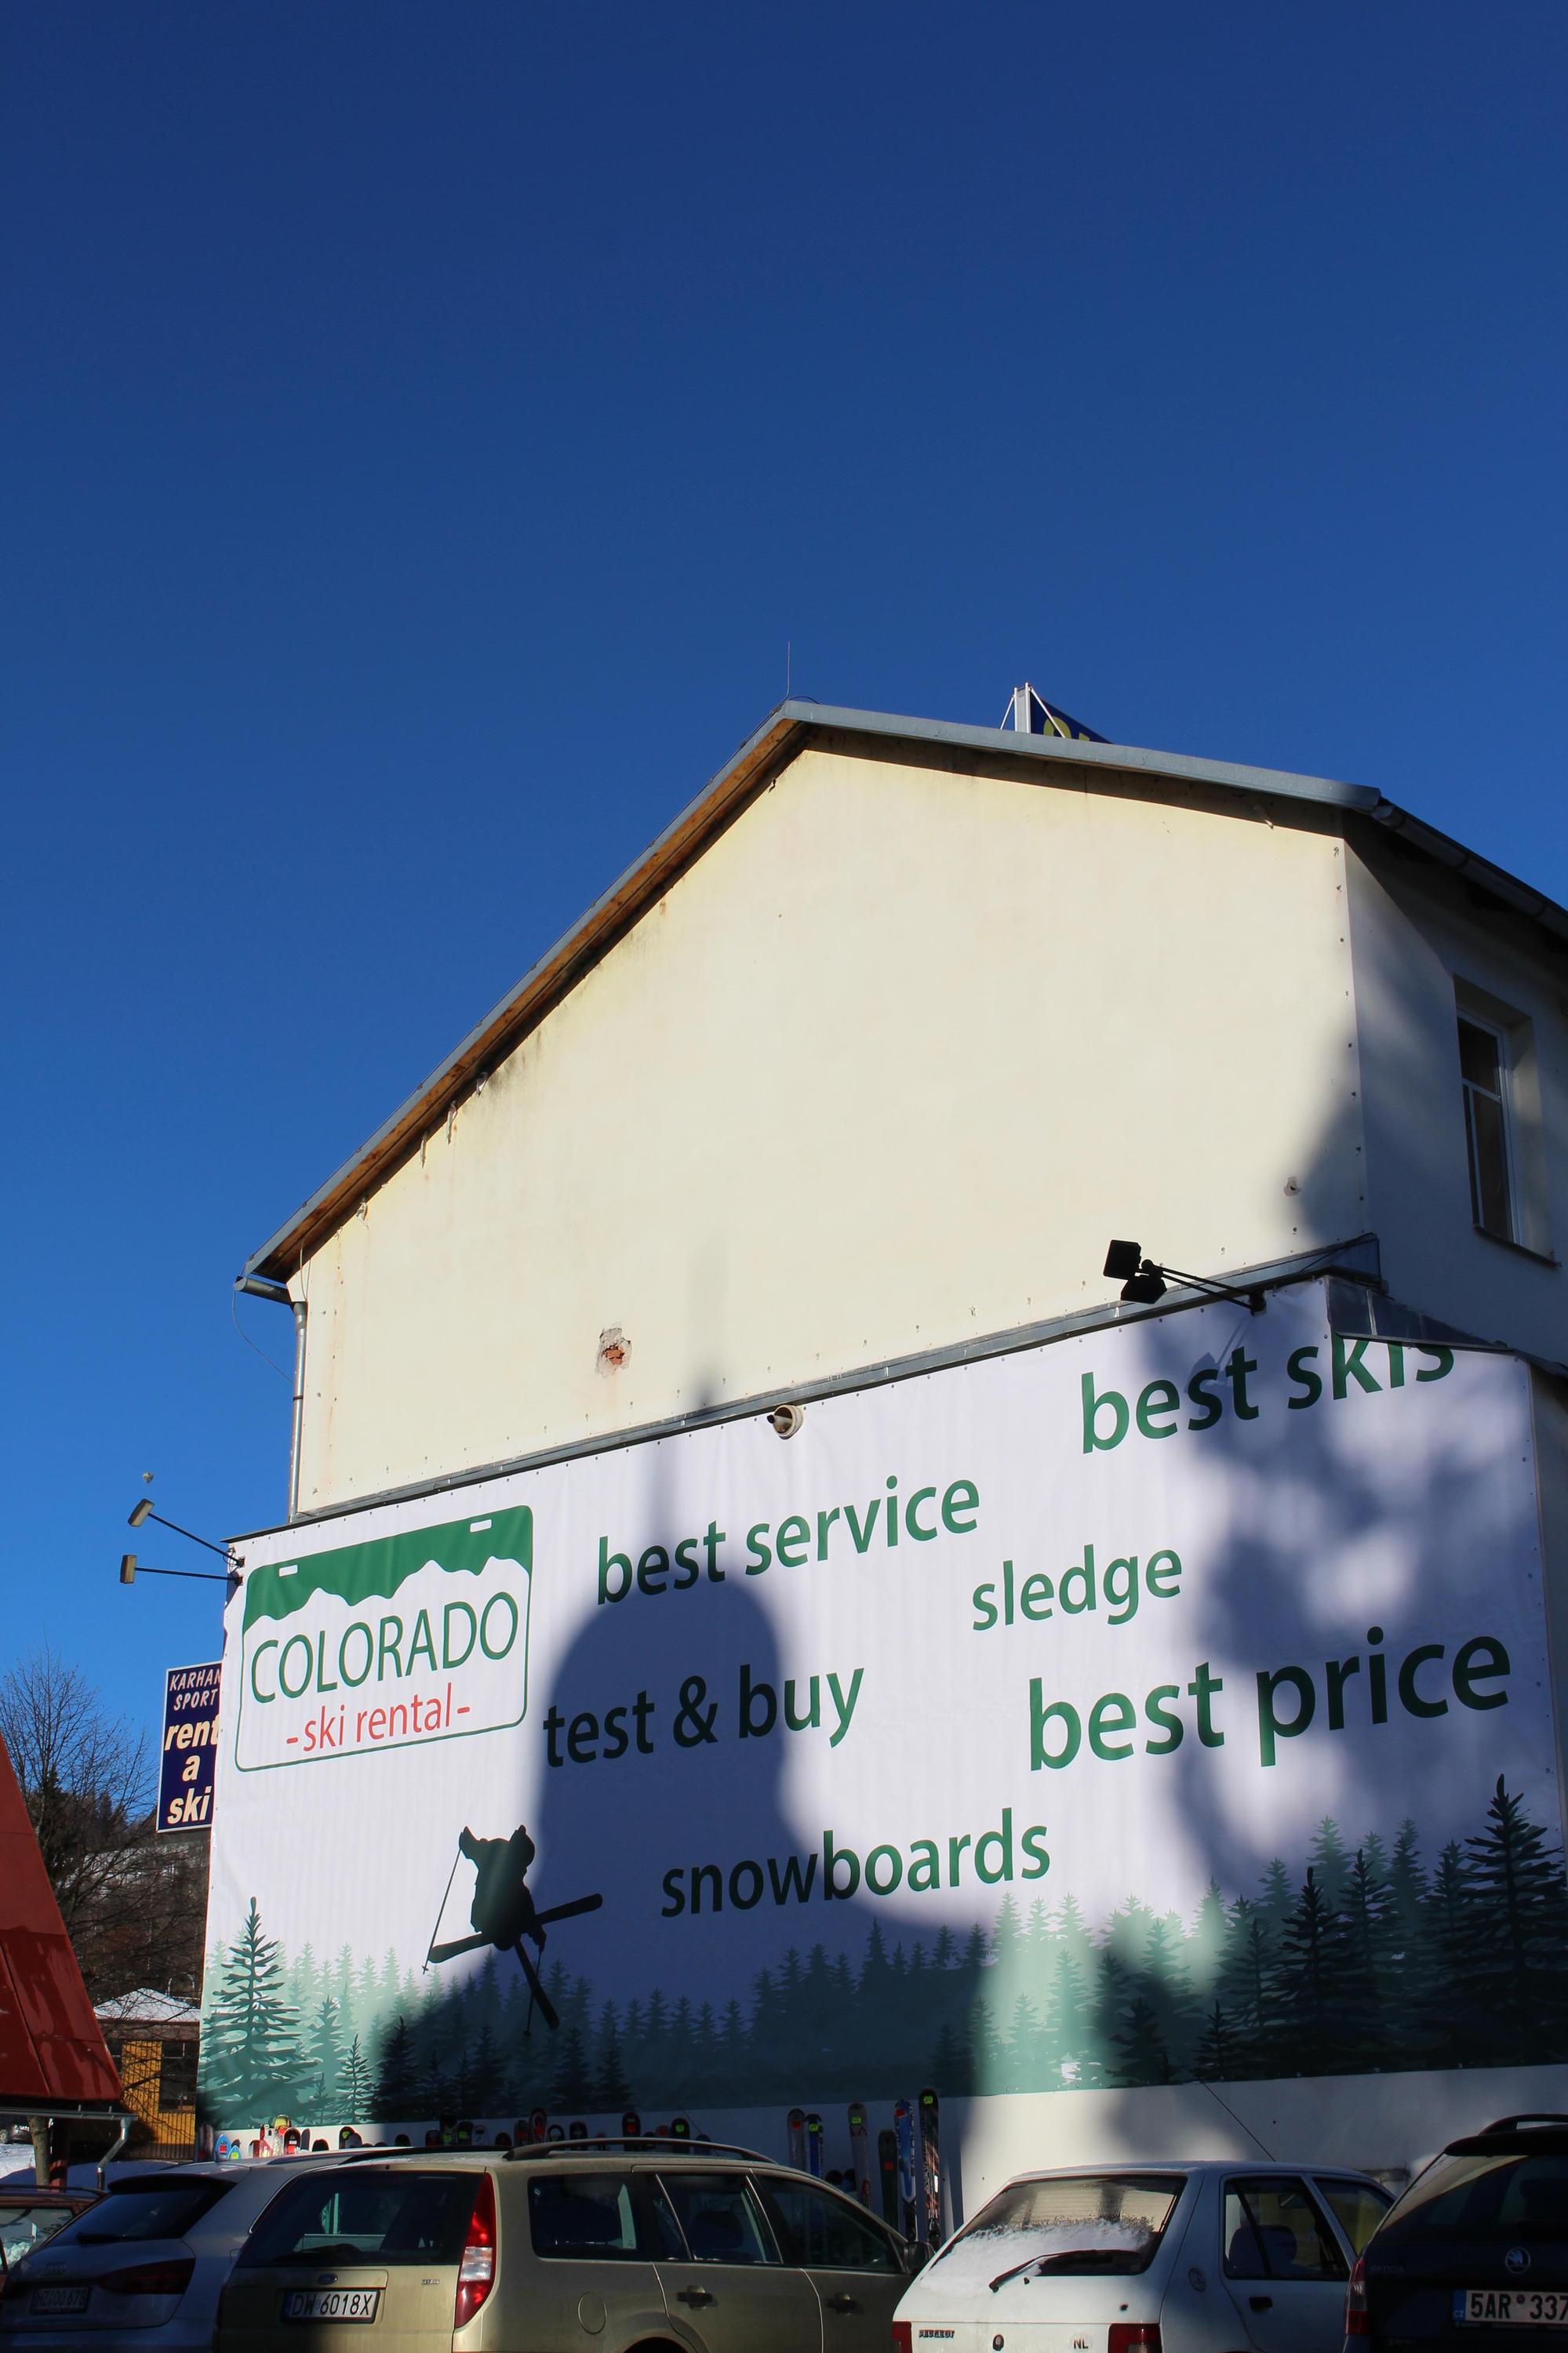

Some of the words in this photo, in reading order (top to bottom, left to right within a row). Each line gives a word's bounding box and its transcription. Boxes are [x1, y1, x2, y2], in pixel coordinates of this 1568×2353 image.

[1081, 1346, 1259, 1457] best
[595, 1520, 727, 1605] best
[745, 1474, 981, 1576] service
[970, 1543, 1184, 1633] sledge
[249, 1591, 518, 1704] COLORADO
[173, 1688, 218, 1711] SPORT
[543, 1690, 655, 1768] test
[673, 1675, 719, 1748] &
[739, 1664, 865, 1749] buy
[1028, 1662, 1226, 1771] best
[1257, 1626, 1511, 1768] price
[165, 1713, 220, 1751] rent
[182, 1754, 201, 1782] a
[167, 1785, 213, 1824] ski
[660, 1807, 1053, 1918] snowboards
[320, 2293, 373, 2315] 6018X
[1471, 2293, 1512, 2319] 5AR
[1074, 2339, 1089, 2349] NL
